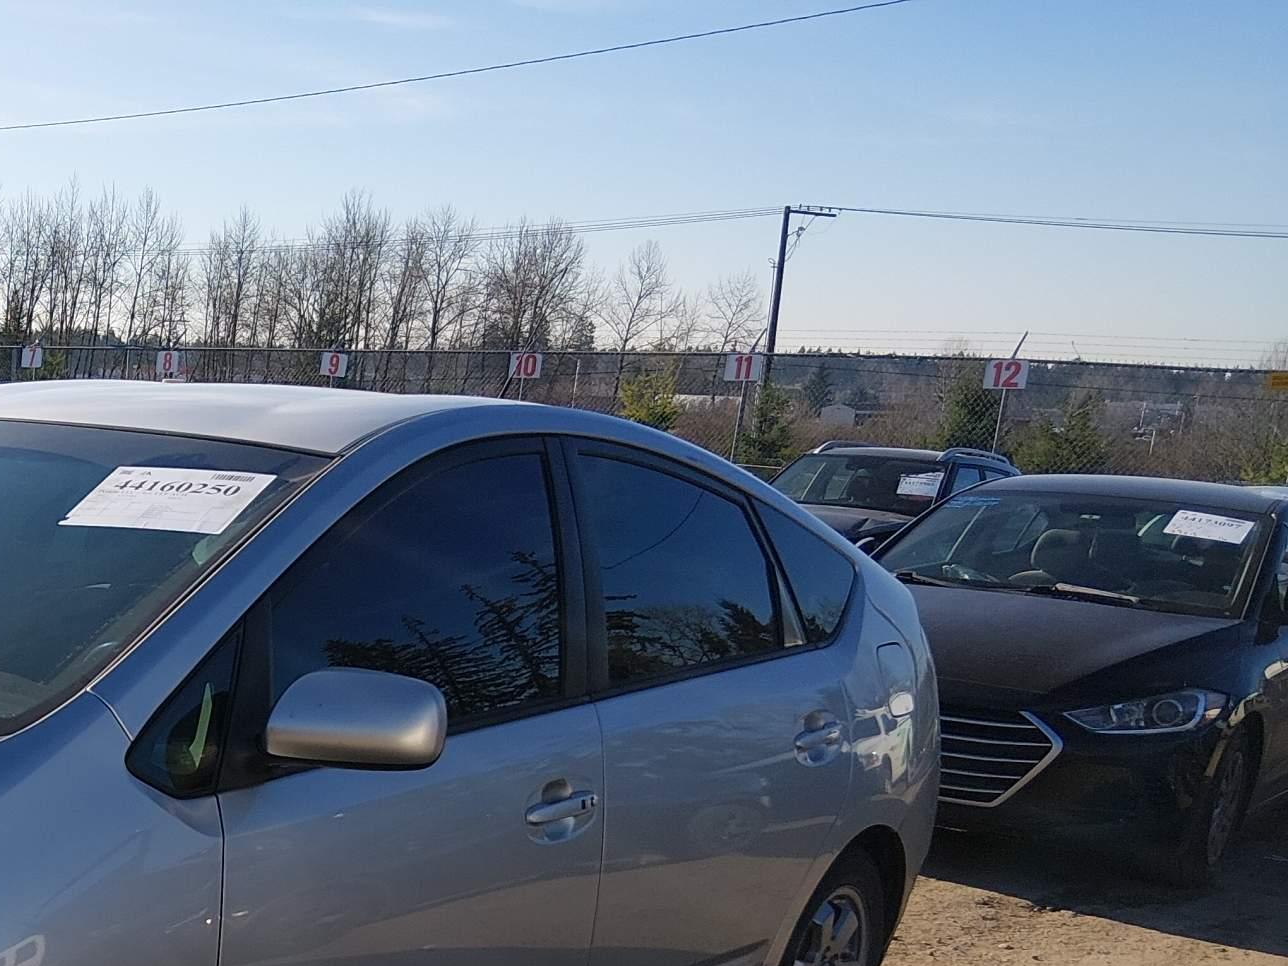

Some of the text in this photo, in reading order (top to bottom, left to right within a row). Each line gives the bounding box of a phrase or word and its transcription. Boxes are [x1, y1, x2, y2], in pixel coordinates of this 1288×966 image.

[28, 348, 37, 367] 7
[162, 351, 173, 372] 8
[328, 353, 340, 375] 9
[515, 354, 538, 377] 10
[734, 355, 754, 380] 11
[992, 360, 1023, 388] 12
[114, 479, 242, 497] 44160250
